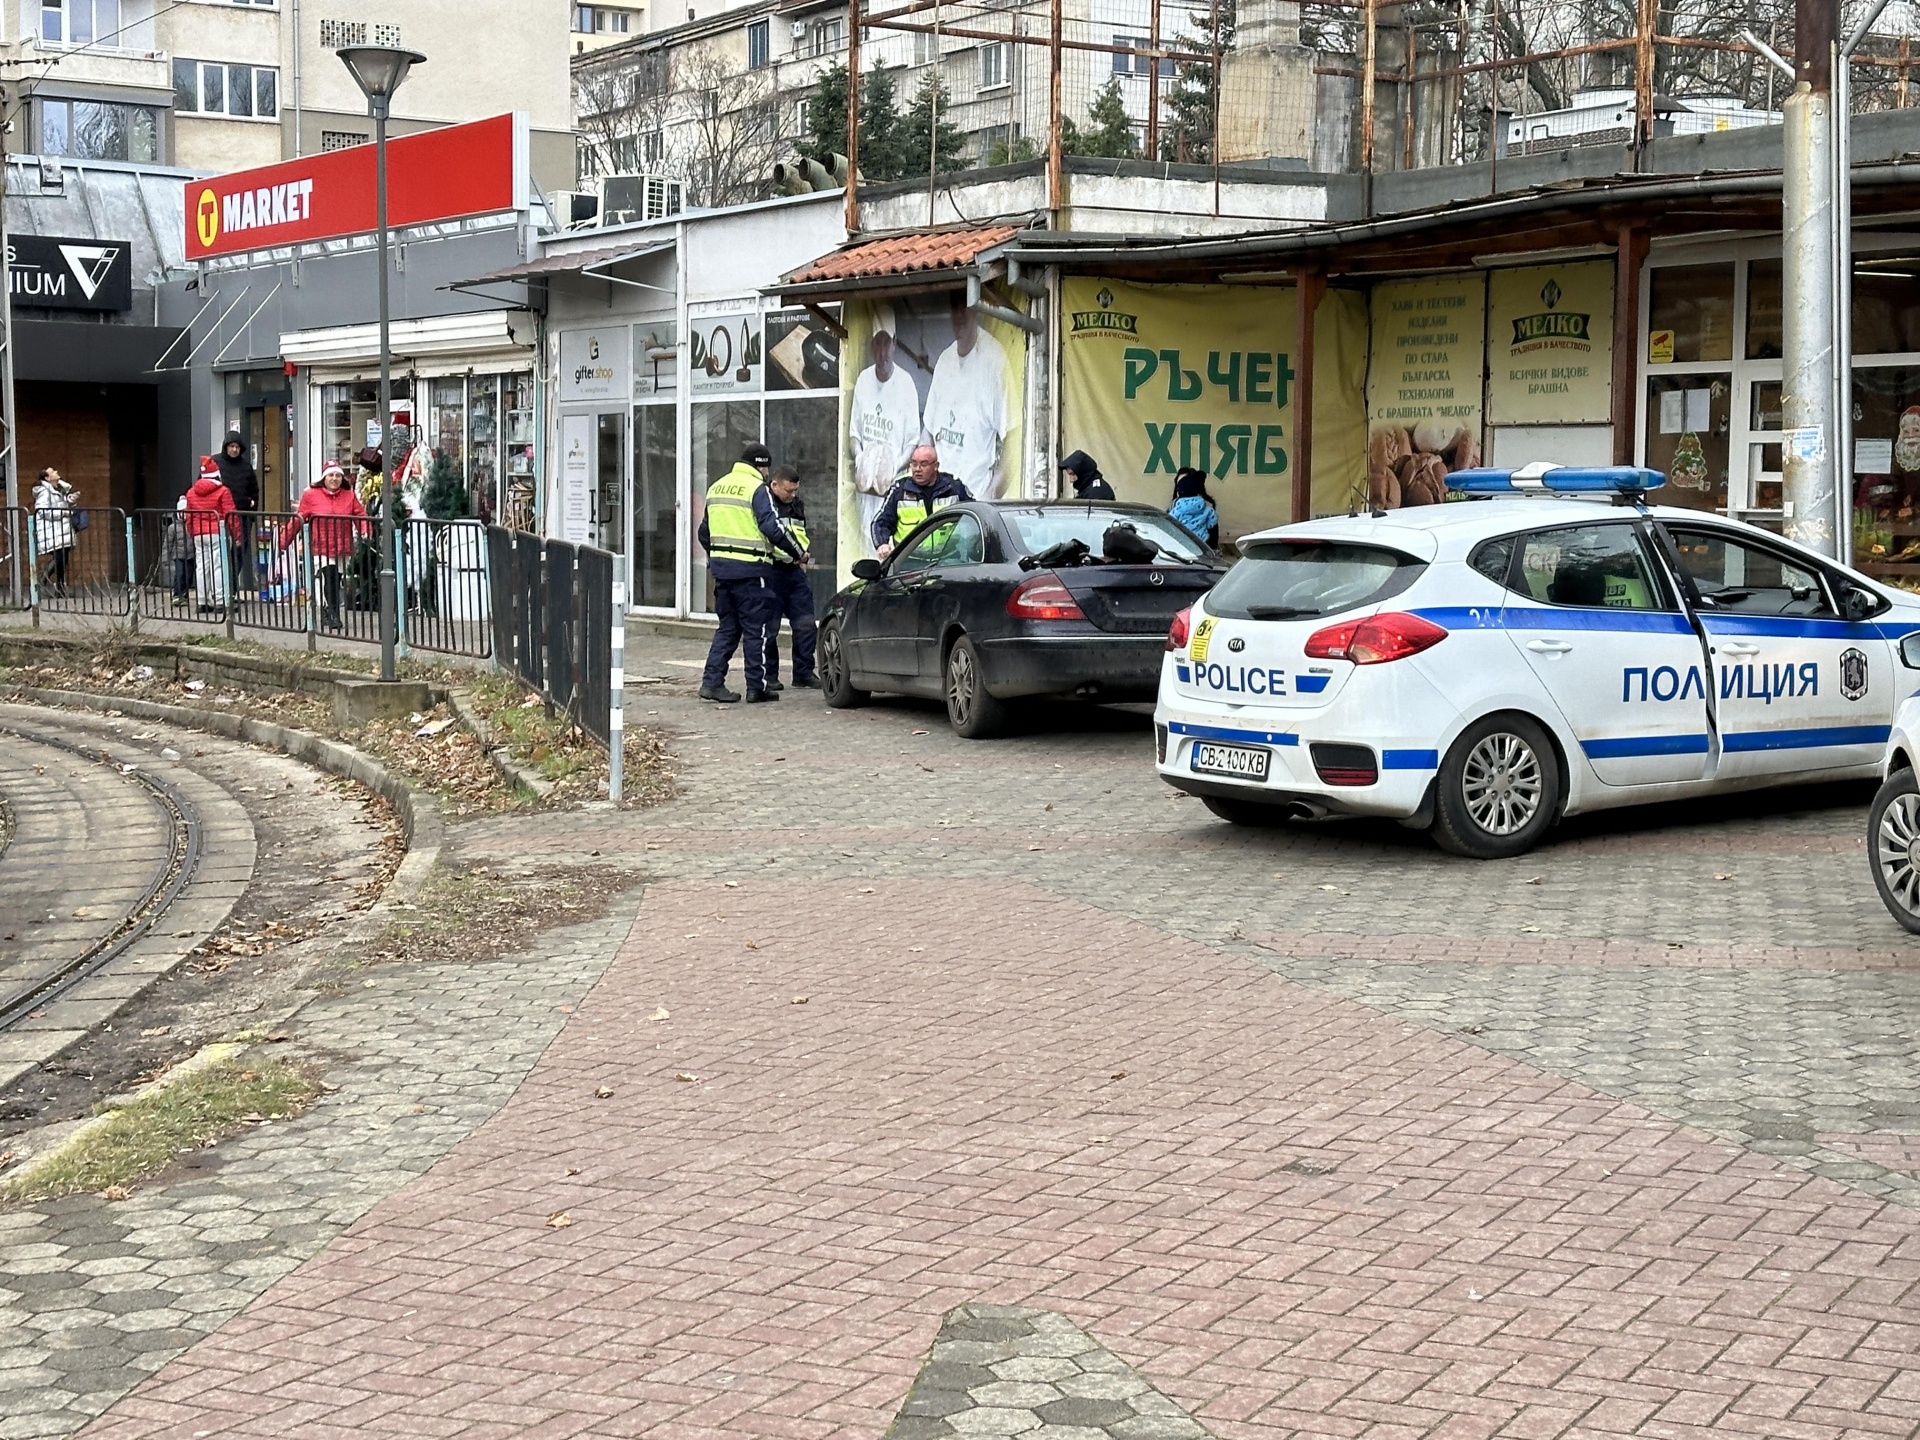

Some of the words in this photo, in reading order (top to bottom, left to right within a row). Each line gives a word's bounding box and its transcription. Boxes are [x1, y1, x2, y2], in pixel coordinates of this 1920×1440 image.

[201, 201, 214, 238] T
[222, 178, 313, 233] MARKET
[8, 271, 66, 296] IUM
[1076, 312, 1132, 330] МЕЛКО
[1517, 314, 1584, 339] МЕЛКО
[1405, 354, 1418, 365] ПО
[1421, 352, 1448, 364] СТАРА
[575, 365, 613, 384] gifter.shop
[1402, 370, 1450, 382] БЪЛГАРСКА
[1509, 367, 1548, 380] ВСИЧКИ
[1551, 366, 1589, 379] ВИДОВЕ
[1398, 388, 1454, 400] ТЕХНОЛОГИЯ
[1528, 382, 1569, 395] БРАШНА
[1387, 406, 1433, 419] БРАШНАТА
[1229, 640, 1243, 649] KIA
[1195, 661, 1287, 696] POLICE
[1622, 662, 1818, 704] ПОЛИЦИЯ
